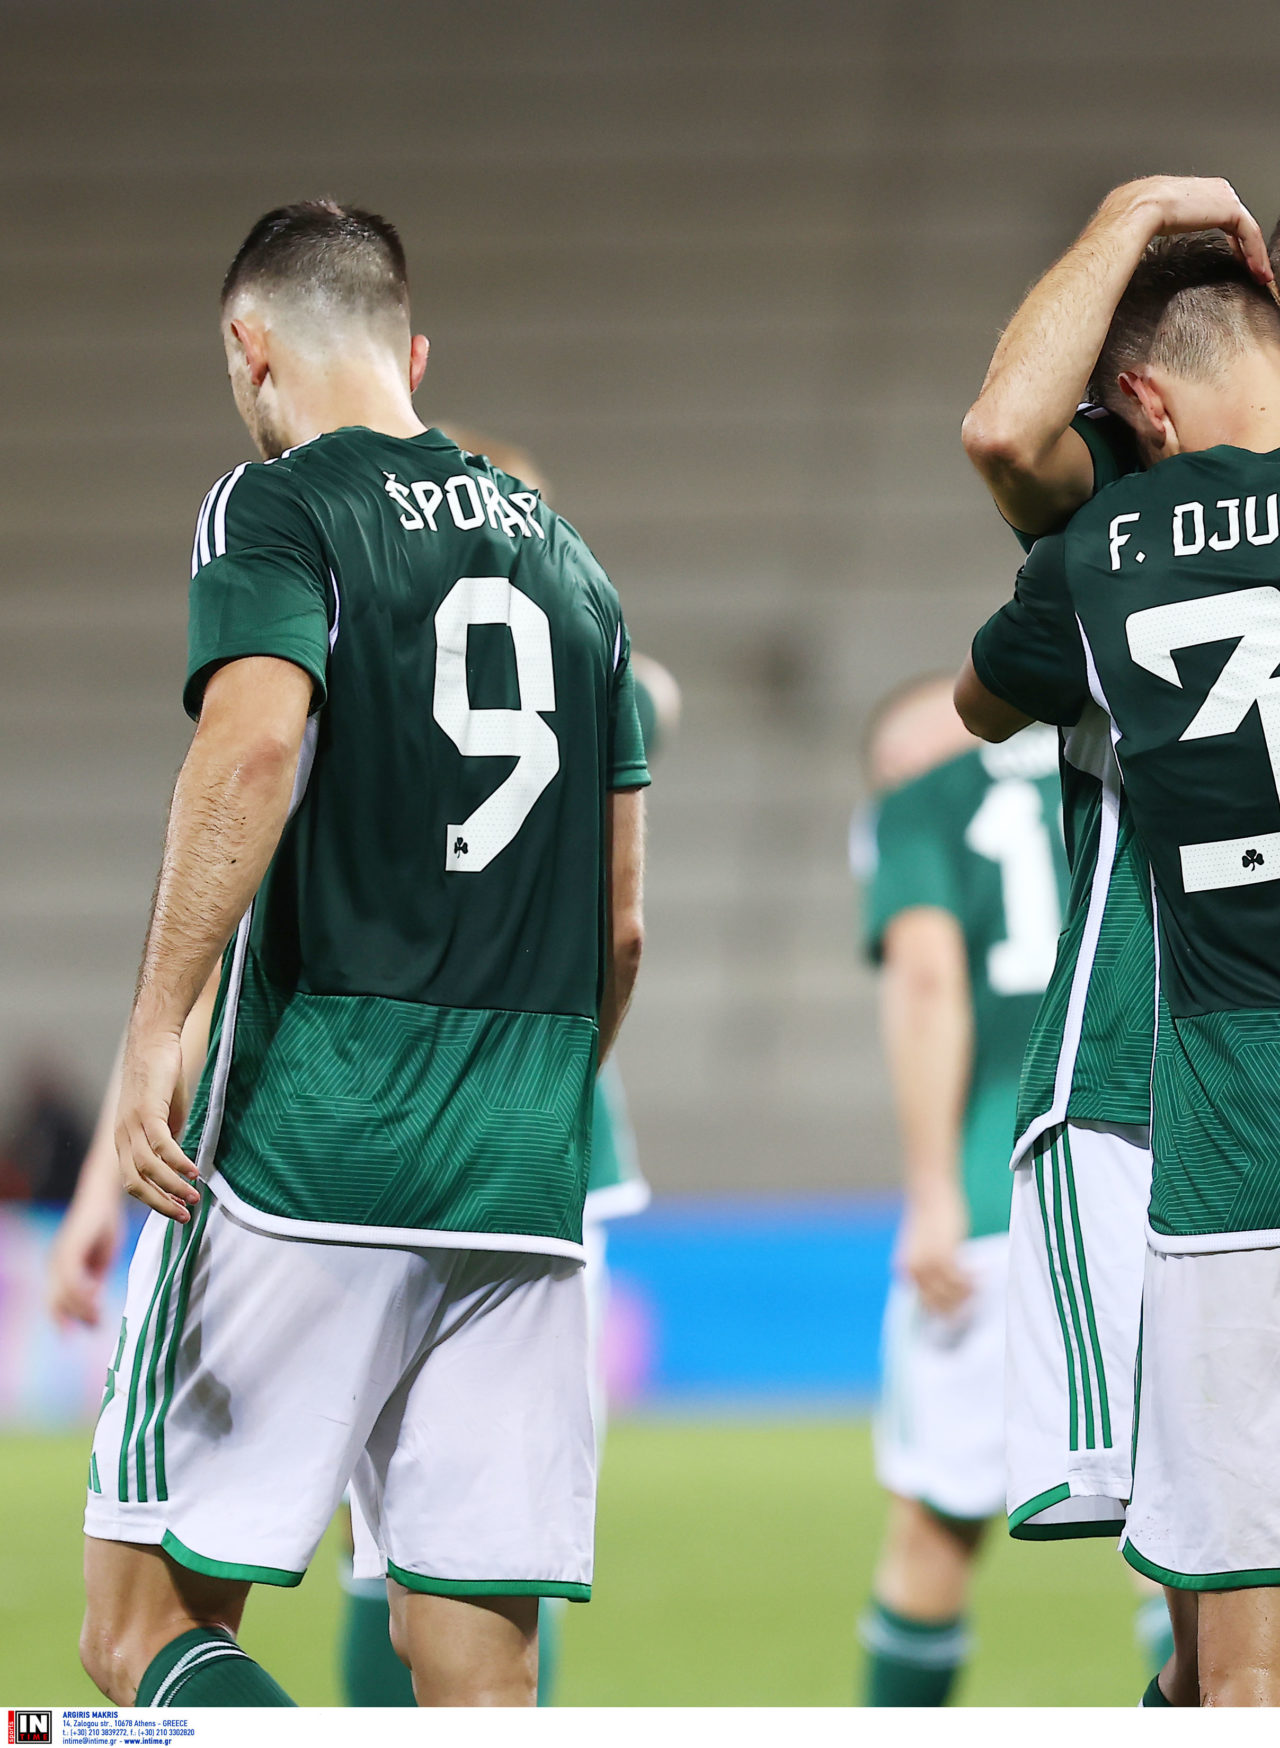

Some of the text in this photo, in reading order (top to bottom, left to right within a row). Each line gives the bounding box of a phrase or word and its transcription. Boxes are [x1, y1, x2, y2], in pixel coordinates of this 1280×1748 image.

[1109, 511, 1146, 571] F.
[433, 577, 560, 872] 9
[964, 776, 1064, 996] 1
